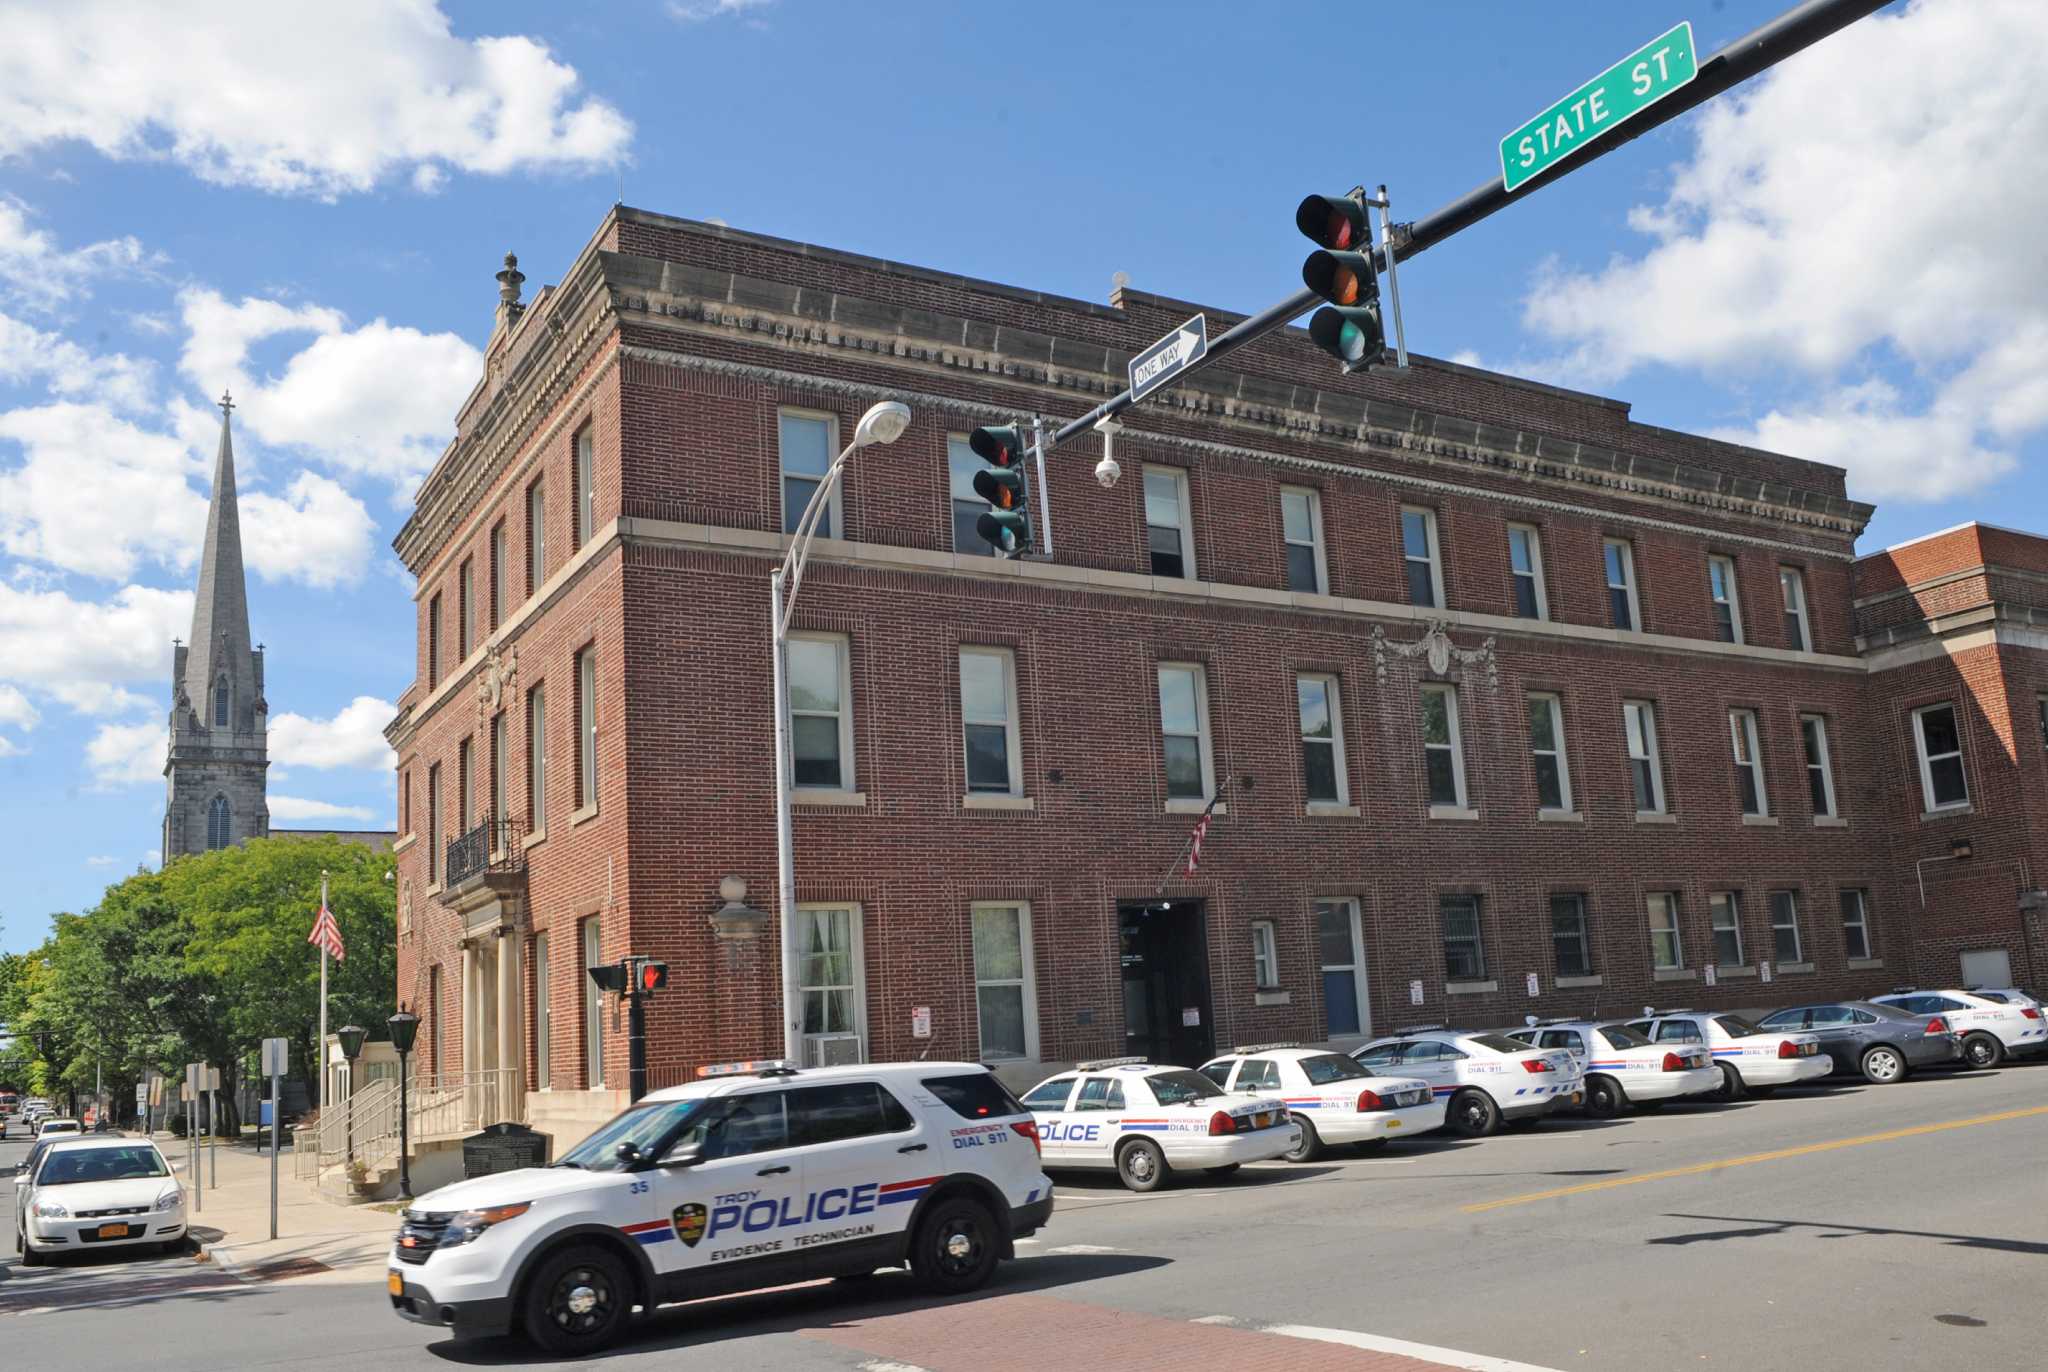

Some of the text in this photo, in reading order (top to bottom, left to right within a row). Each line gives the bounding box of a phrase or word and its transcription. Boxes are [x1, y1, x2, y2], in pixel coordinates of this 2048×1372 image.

[1519, 47, 1669, 167] STATE ST
[1137, 343, 1179, 383] ONE WAY
[950, 1124, 1003, 1137] EMERGENCY
[1038, 1125, 1100, 1141] OLICE
[1169, 1123, 1207, 1132] DIAL 911
[953, 1131, 1008, 1149] DIAL 911
[630, 1180, 649, 1194] 35
[714, 1189, 761, 1206] TROY
[706, 1182, 879, 1239] POLICE
[710, 1223, 875, 1262] EVIDENCE TECHNICIAN
